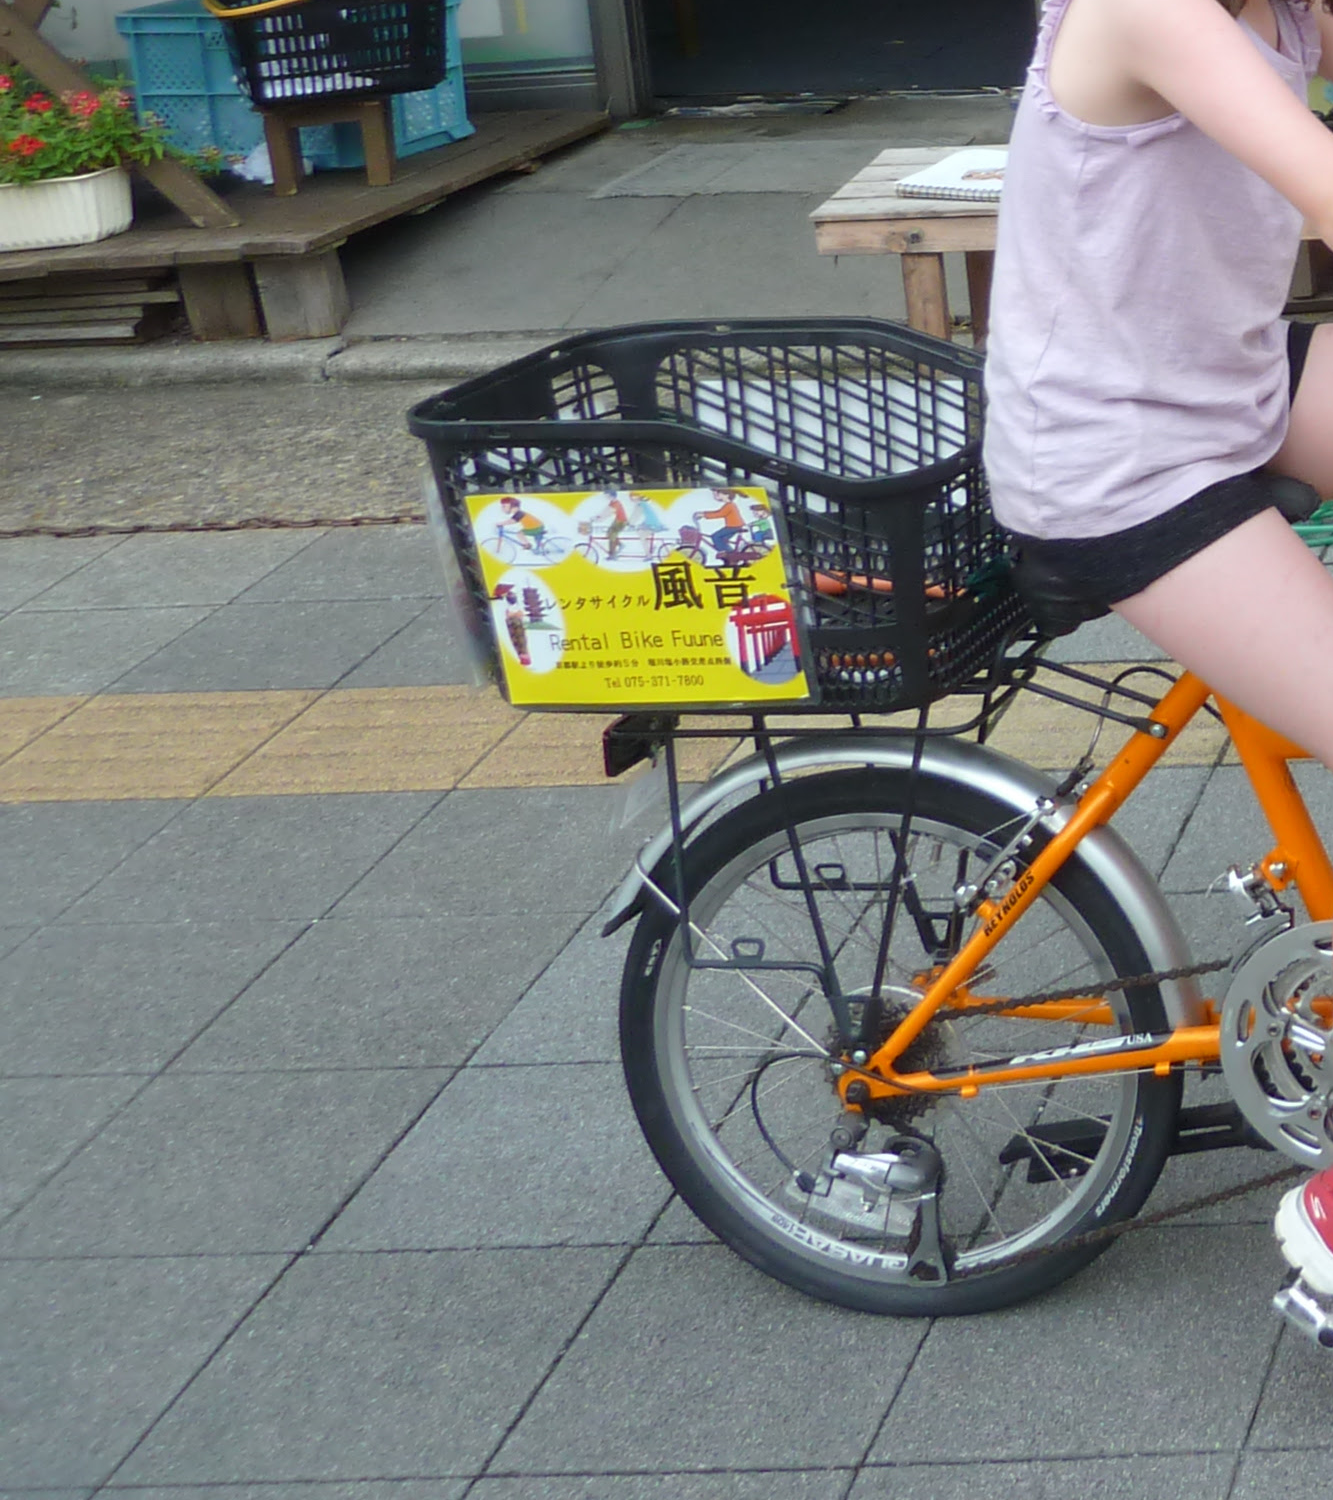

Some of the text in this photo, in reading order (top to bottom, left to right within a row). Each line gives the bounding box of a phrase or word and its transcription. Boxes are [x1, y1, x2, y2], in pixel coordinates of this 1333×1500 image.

[545, 560, 756, 612] レンタサイクル 風音
[550, 630, 724, 652] Rental Bike Fuune
[624, 674, 705, 689] 075-371-7800
[984, 870, 1035, 937] REYNOLDS
[1127, 1032, 1153, 1045] USA
